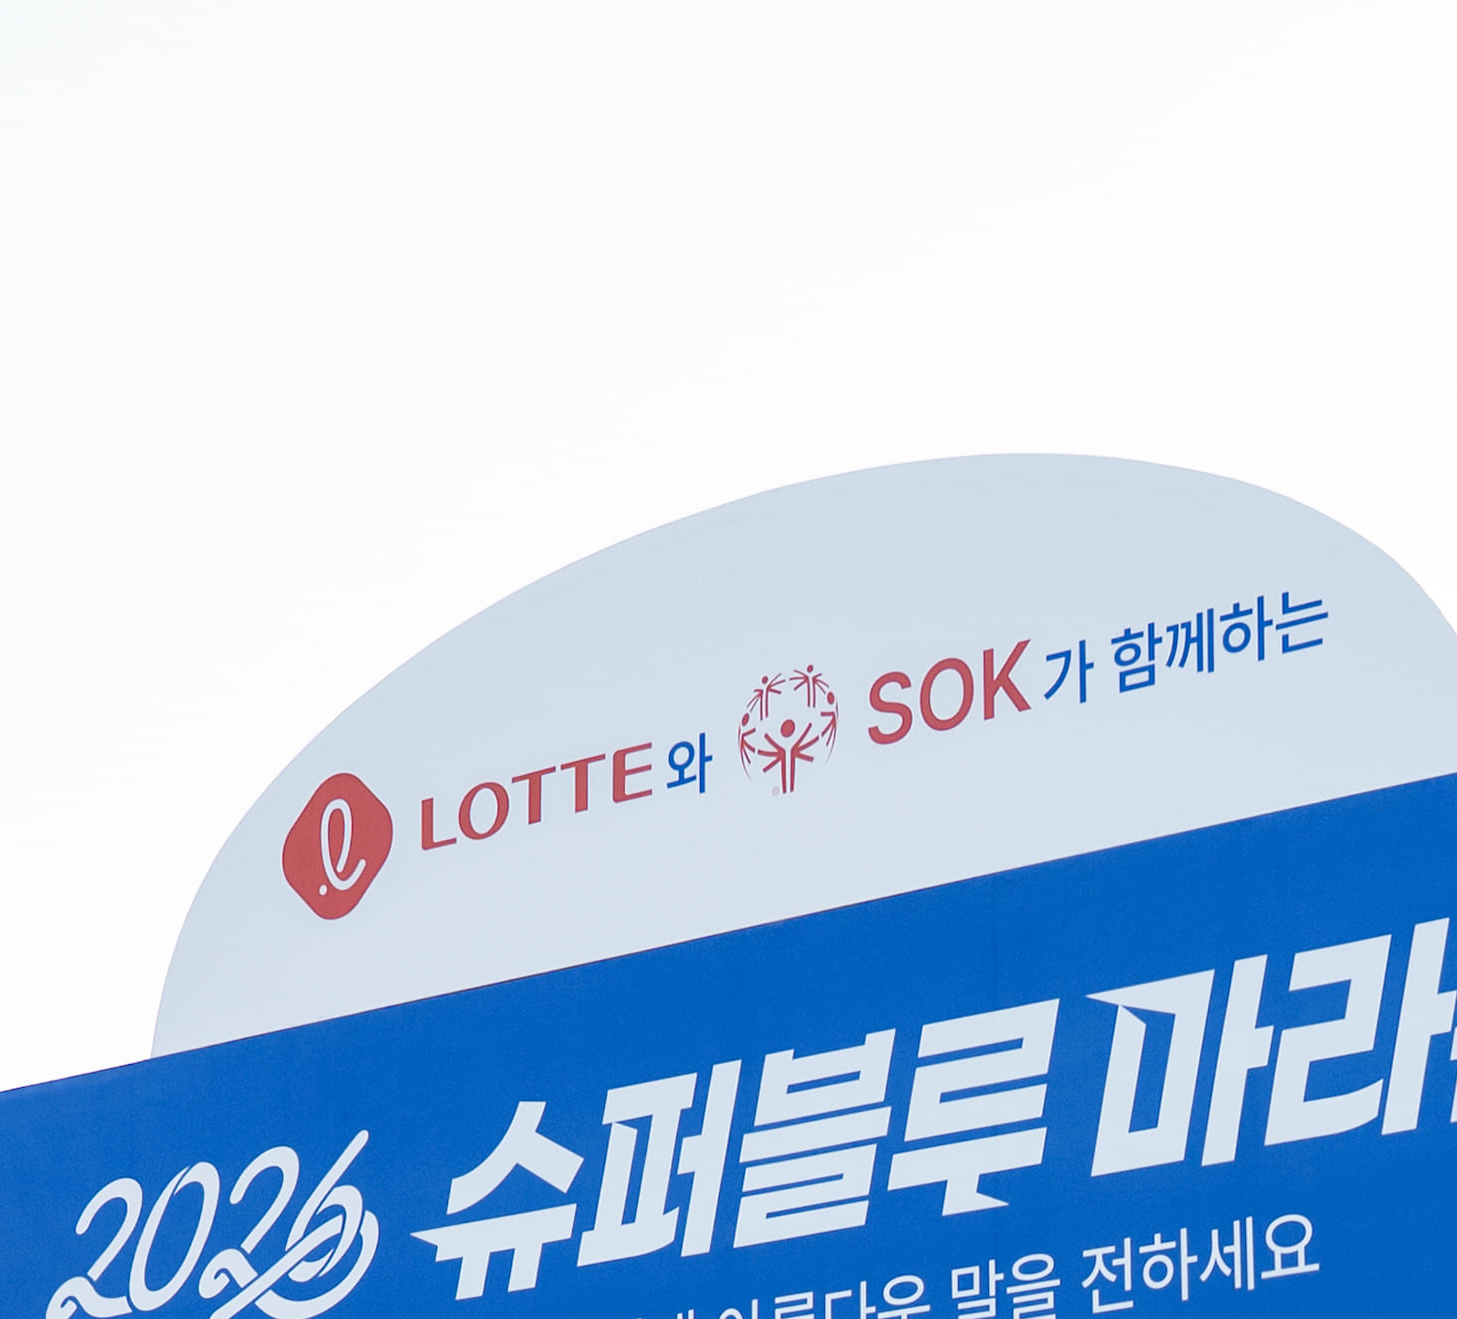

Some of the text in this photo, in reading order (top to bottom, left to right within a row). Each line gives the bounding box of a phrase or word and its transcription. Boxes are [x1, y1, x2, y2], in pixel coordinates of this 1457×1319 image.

[1112, 591, 1330, 693] 함께하는
[410, 998, 1060, 1300] 슈퍼블루
[1081, 1213, 1320, 1311] 전하세요
